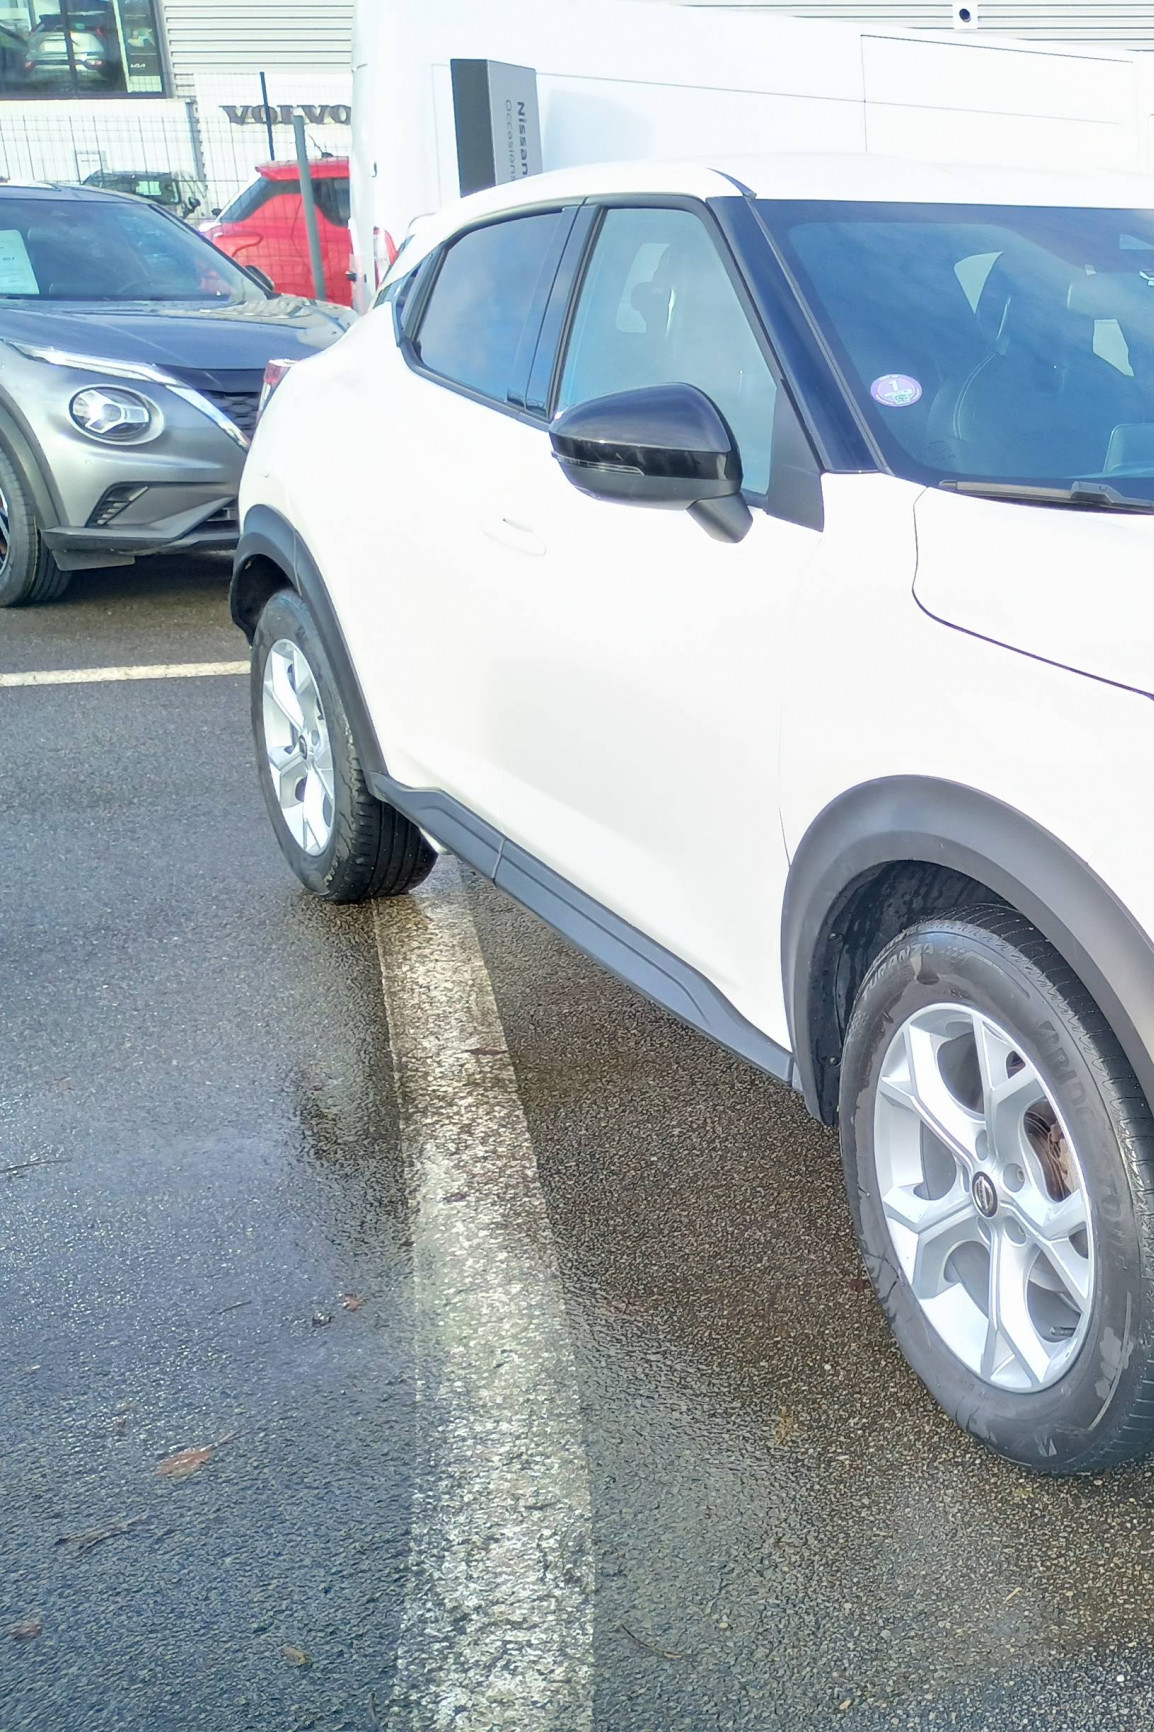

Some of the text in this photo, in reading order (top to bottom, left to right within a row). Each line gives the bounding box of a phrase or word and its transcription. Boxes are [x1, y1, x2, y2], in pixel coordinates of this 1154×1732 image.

[218, 104, 352, 126] VOLVO
[517, 101, 529, 176] Nissan
[861, 942, 935, 1001] TURANZA
